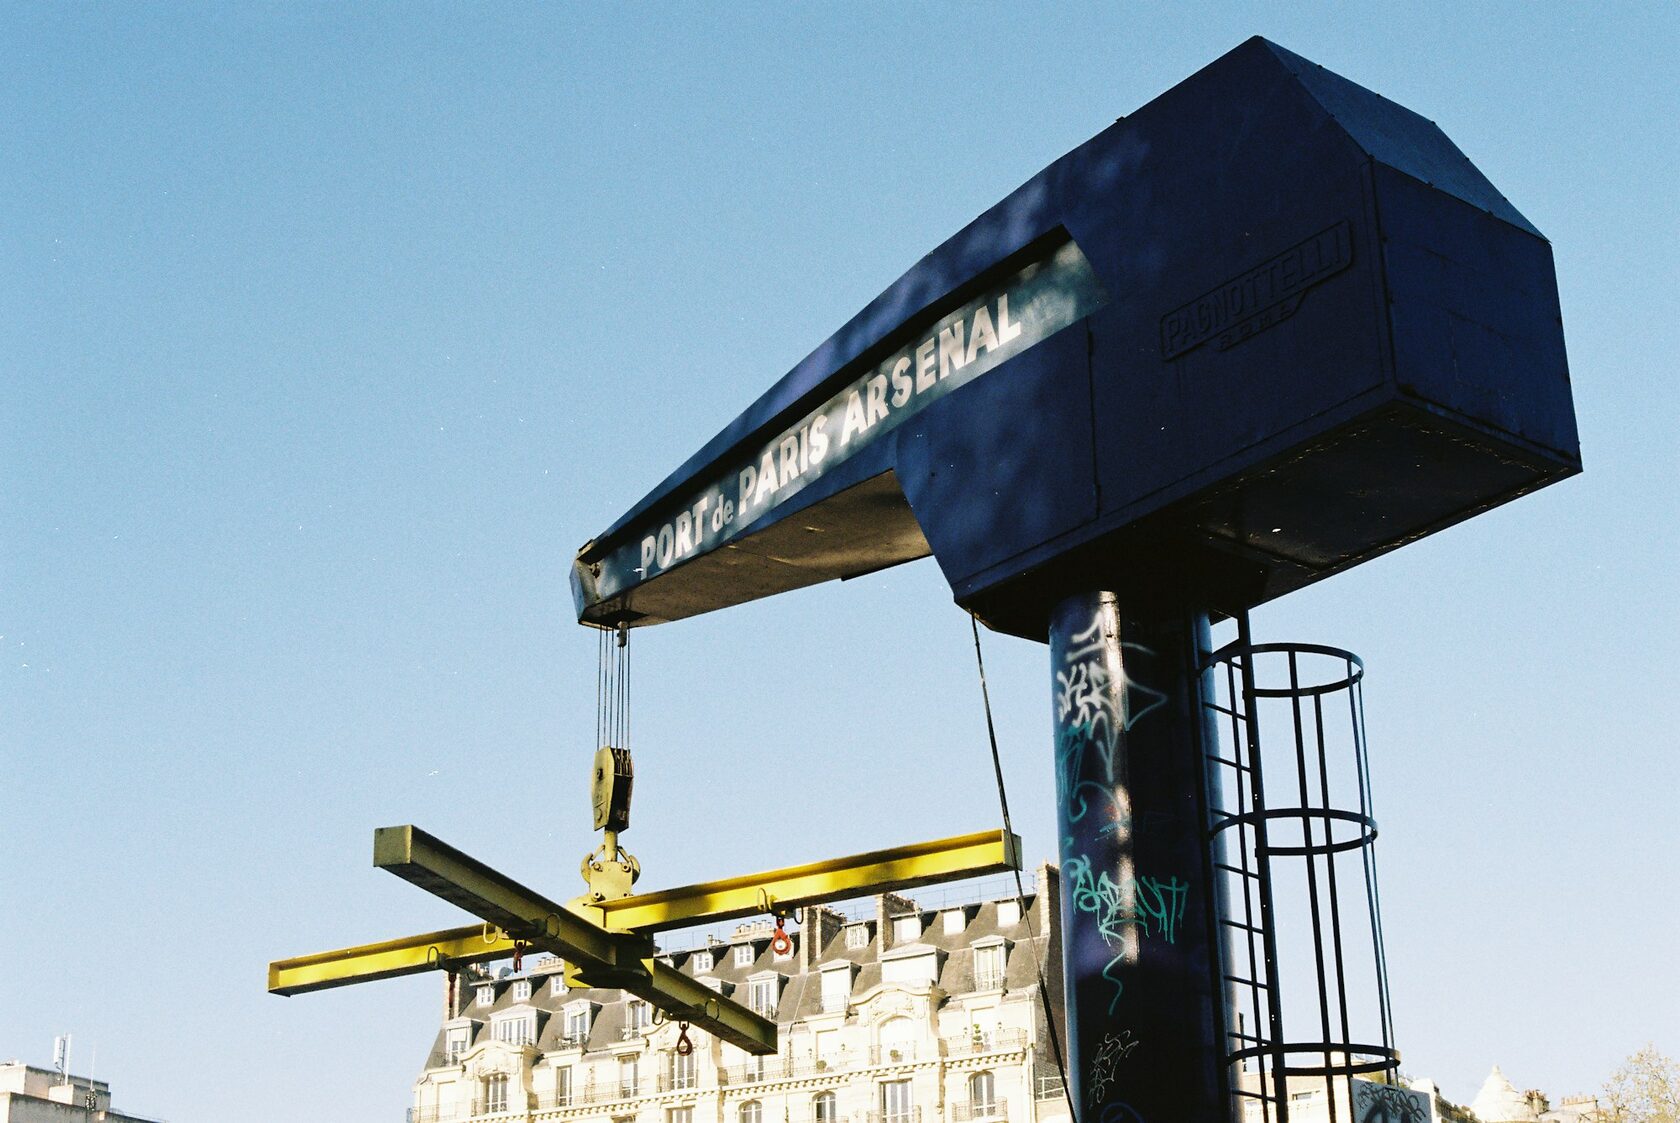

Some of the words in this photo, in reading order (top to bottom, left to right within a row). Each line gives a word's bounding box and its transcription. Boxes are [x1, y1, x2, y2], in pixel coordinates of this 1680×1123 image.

[1167, 229, 1342, 353] PAGNOTTELLI
[641, 497, 707, 580] PORT
[712, 494, 734, 533] de
[739, 415, 829, 516] PARIS
[840, 293, 1021, 447] ARSENAL
